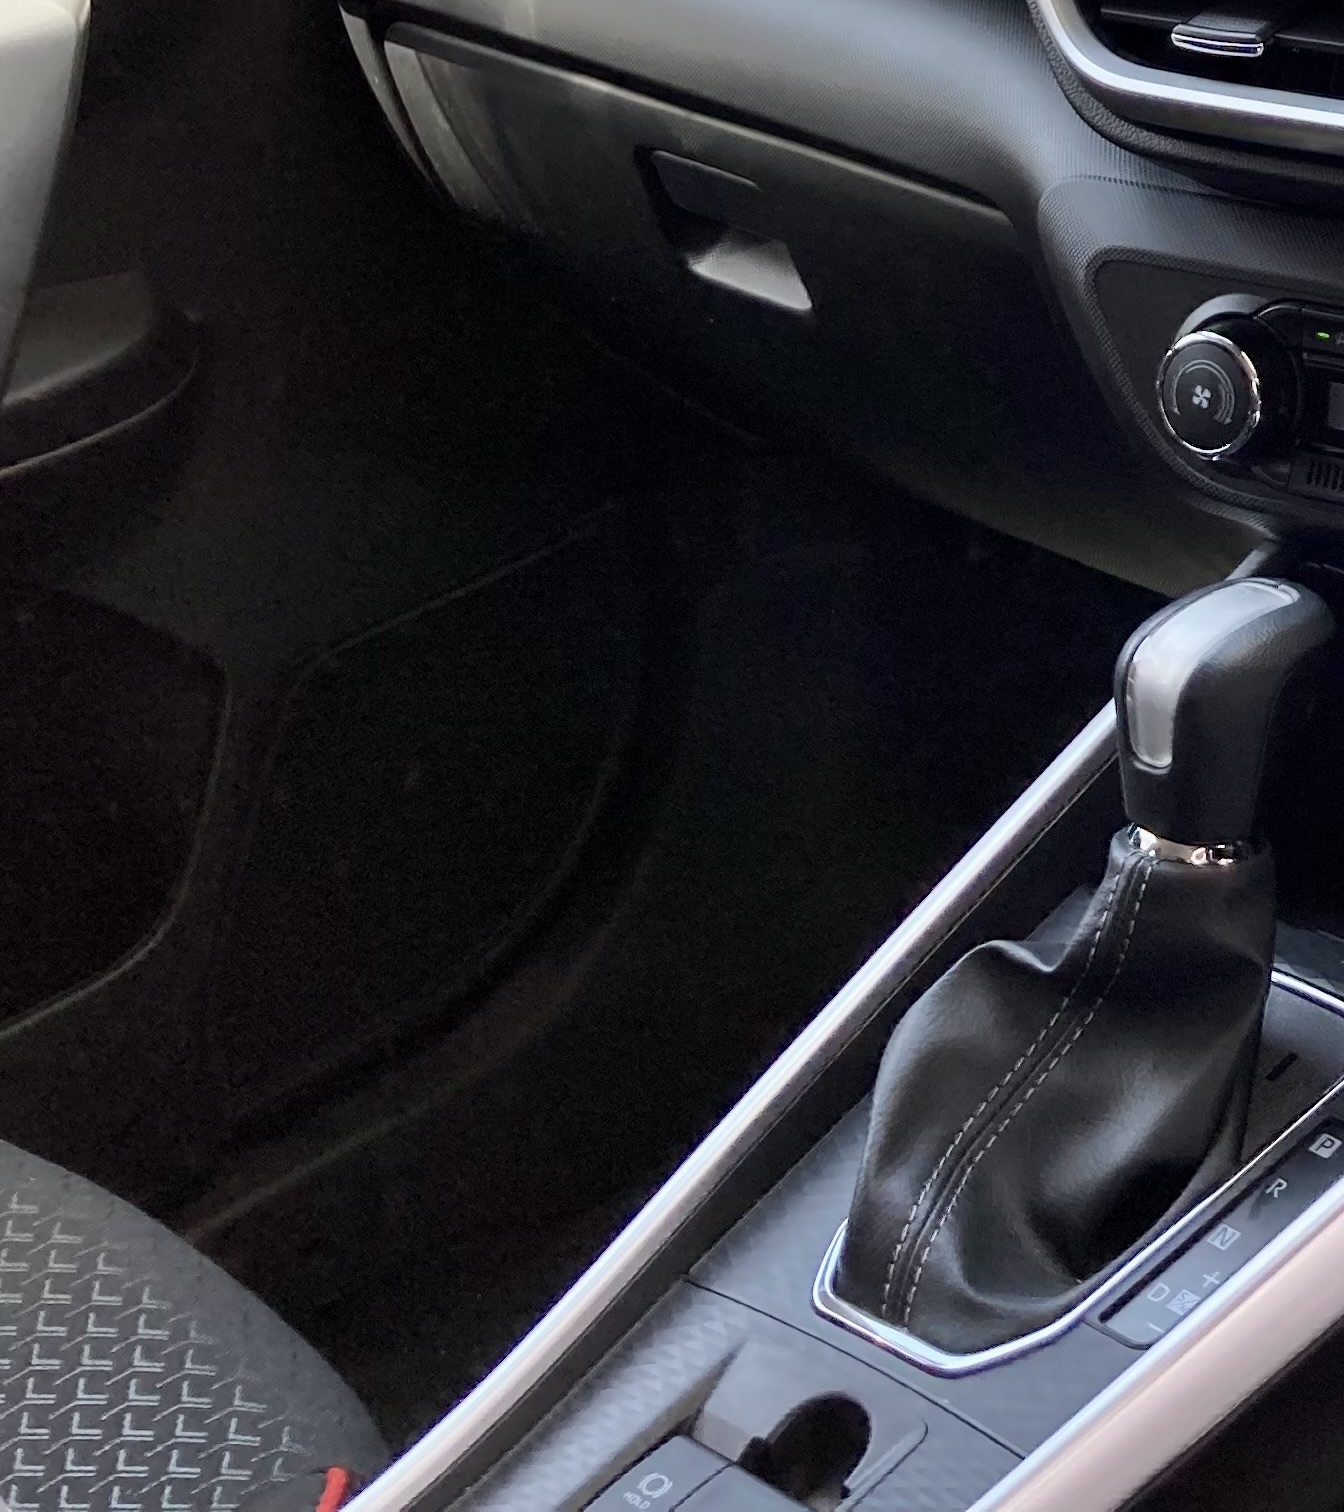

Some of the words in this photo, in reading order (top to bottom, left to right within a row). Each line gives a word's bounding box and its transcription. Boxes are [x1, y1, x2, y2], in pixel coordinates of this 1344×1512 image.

[1265, 1177, 1288, 1199] R
[1211, 1225, 1238, 1249] N
[1146, 1282, 1171, 1303] D
